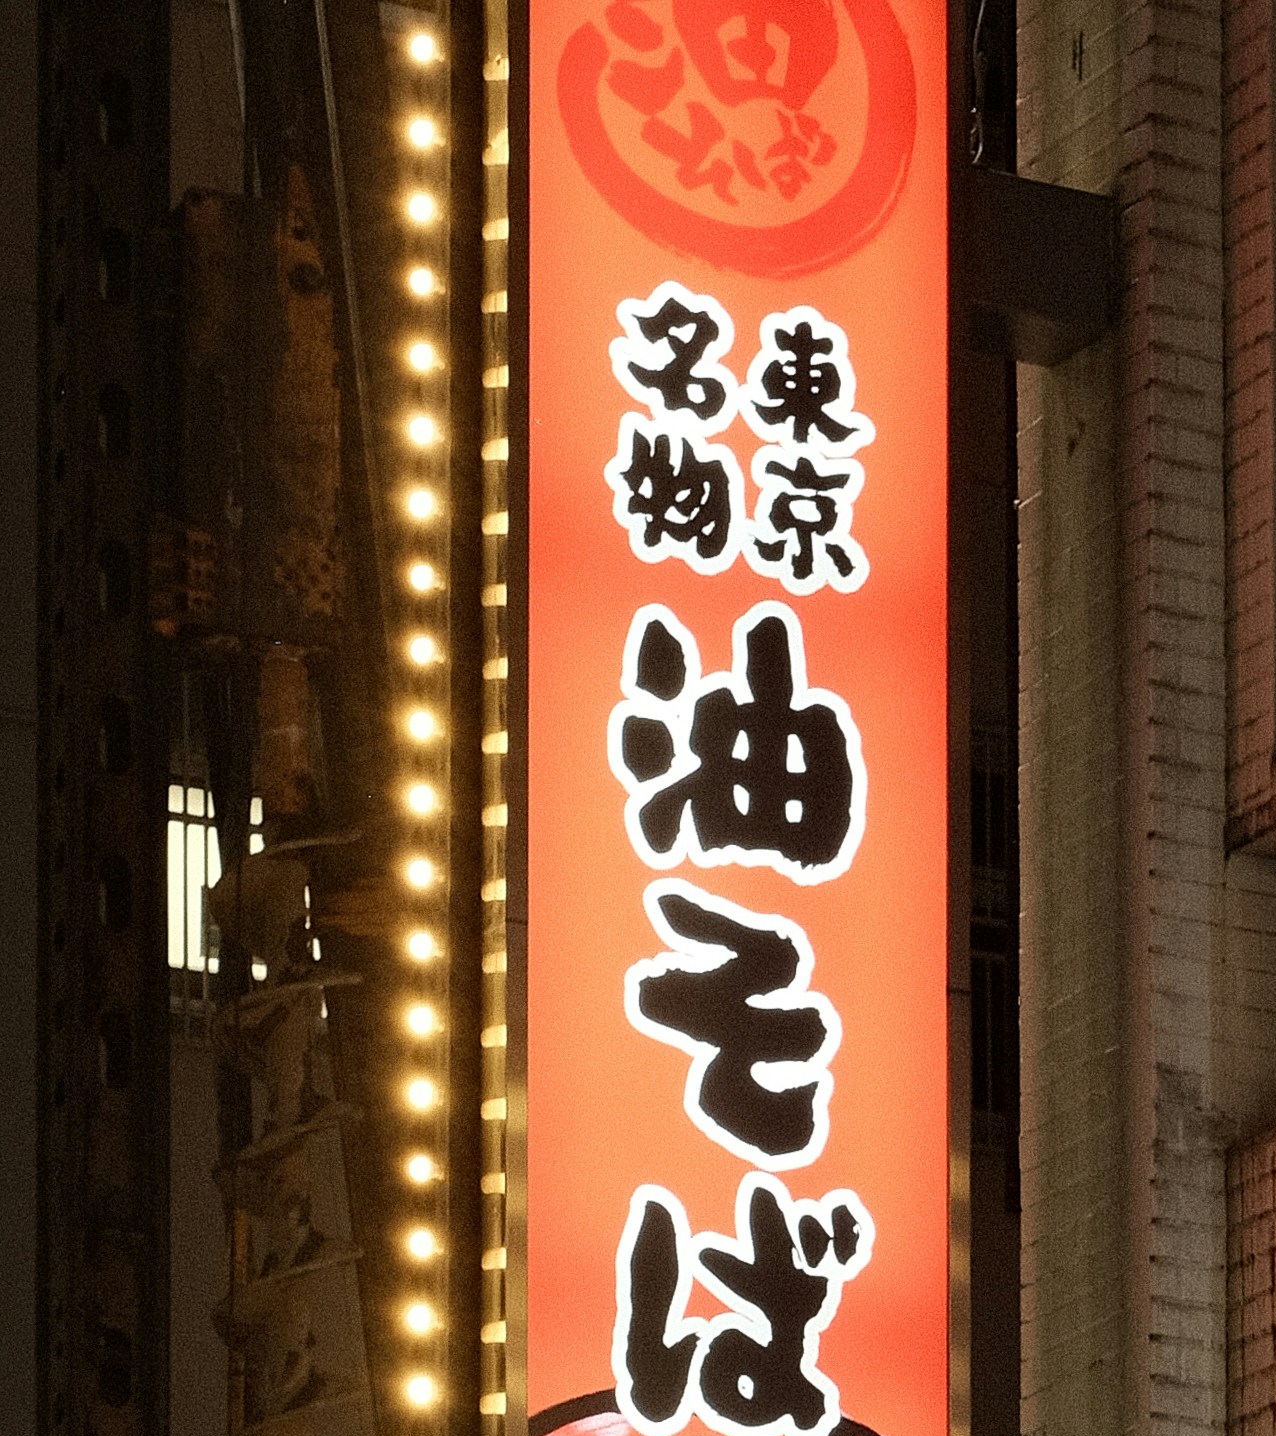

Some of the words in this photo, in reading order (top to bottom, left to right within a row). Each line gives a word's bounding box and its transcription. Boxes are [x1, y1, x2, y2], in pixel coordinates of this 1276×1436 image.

[619, 297, 732, 561] 名物
[752, 321, 858, 582] 東京
[622, 615, 860, 1431] 油そば
